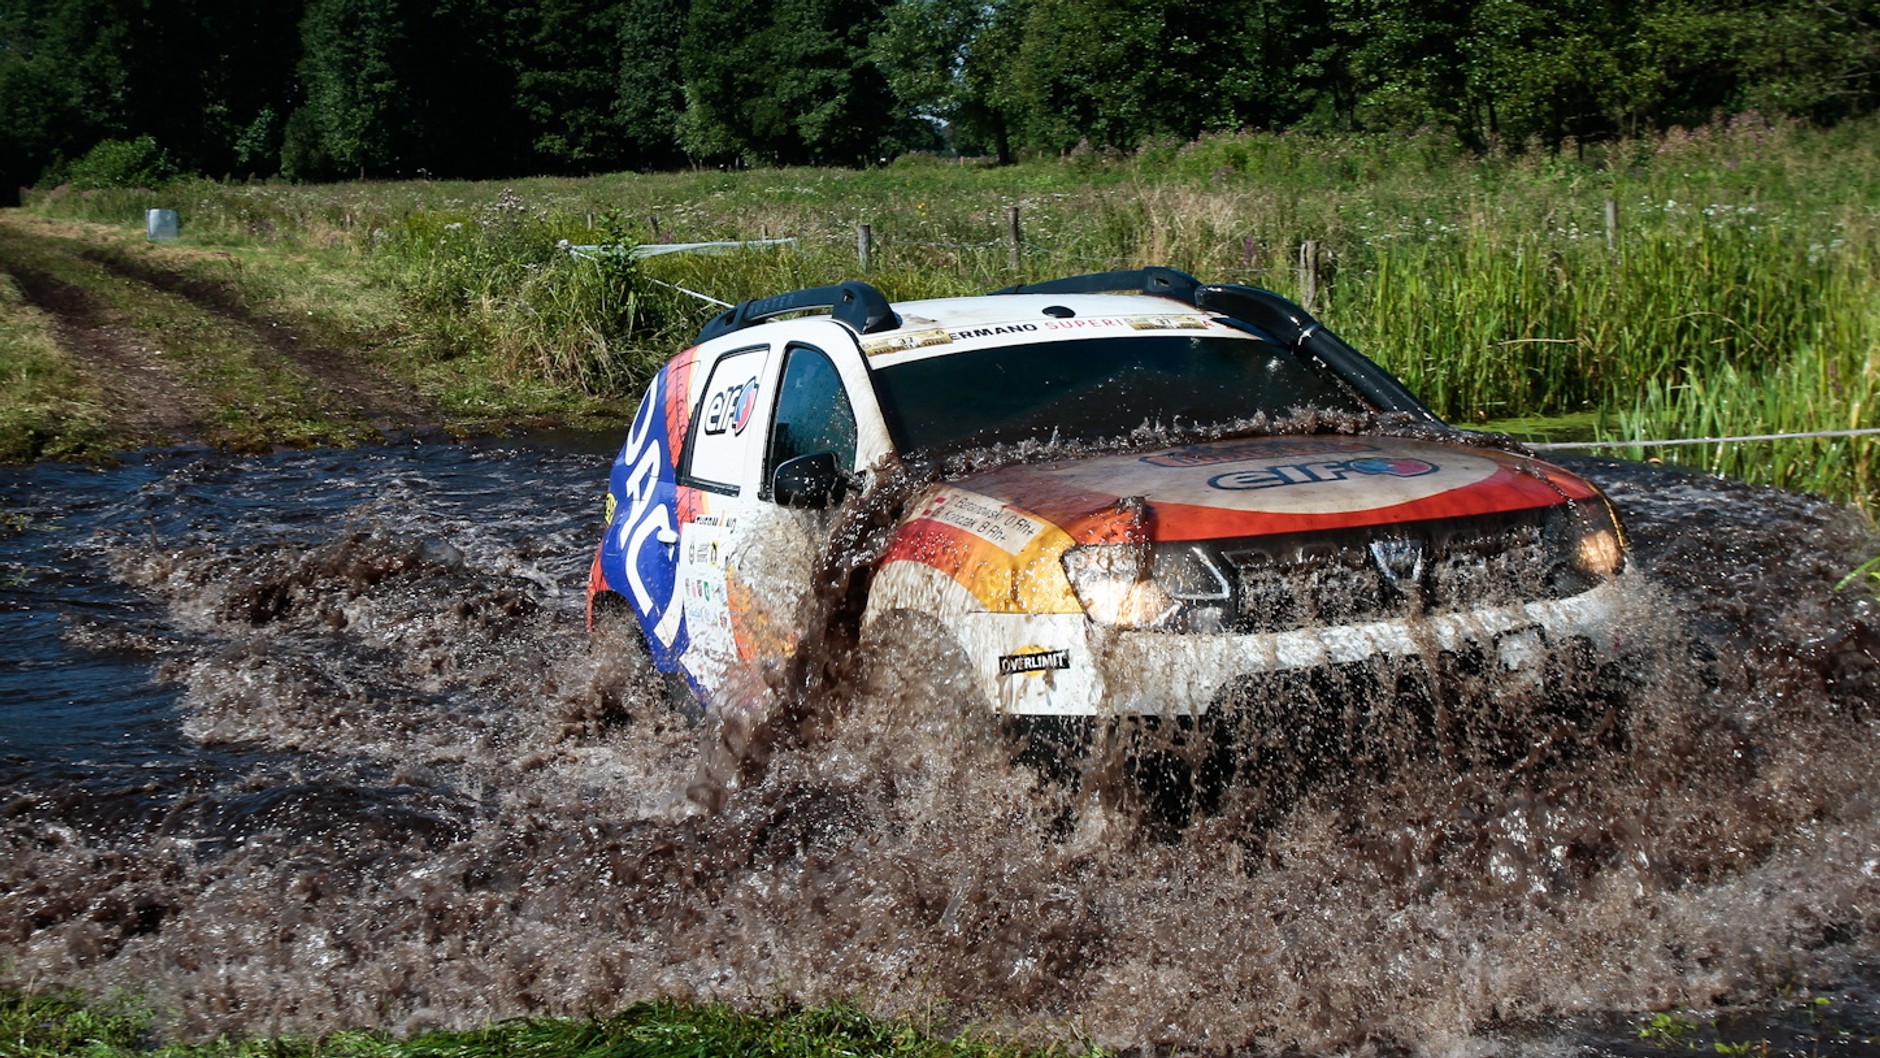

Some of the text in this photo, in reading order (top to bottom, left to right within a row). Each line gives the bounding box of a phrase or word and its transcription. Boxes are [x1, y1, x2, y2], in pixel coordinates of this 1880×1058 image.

[705, 384, 745, 436] elf
[1207, 462, 1350, 491] elf
[988, 525, 1007, 542] Rh+
[1013, 518, 1036, 537] Rh+
[1001, 652, 1066, 672] OVERLIMIT
